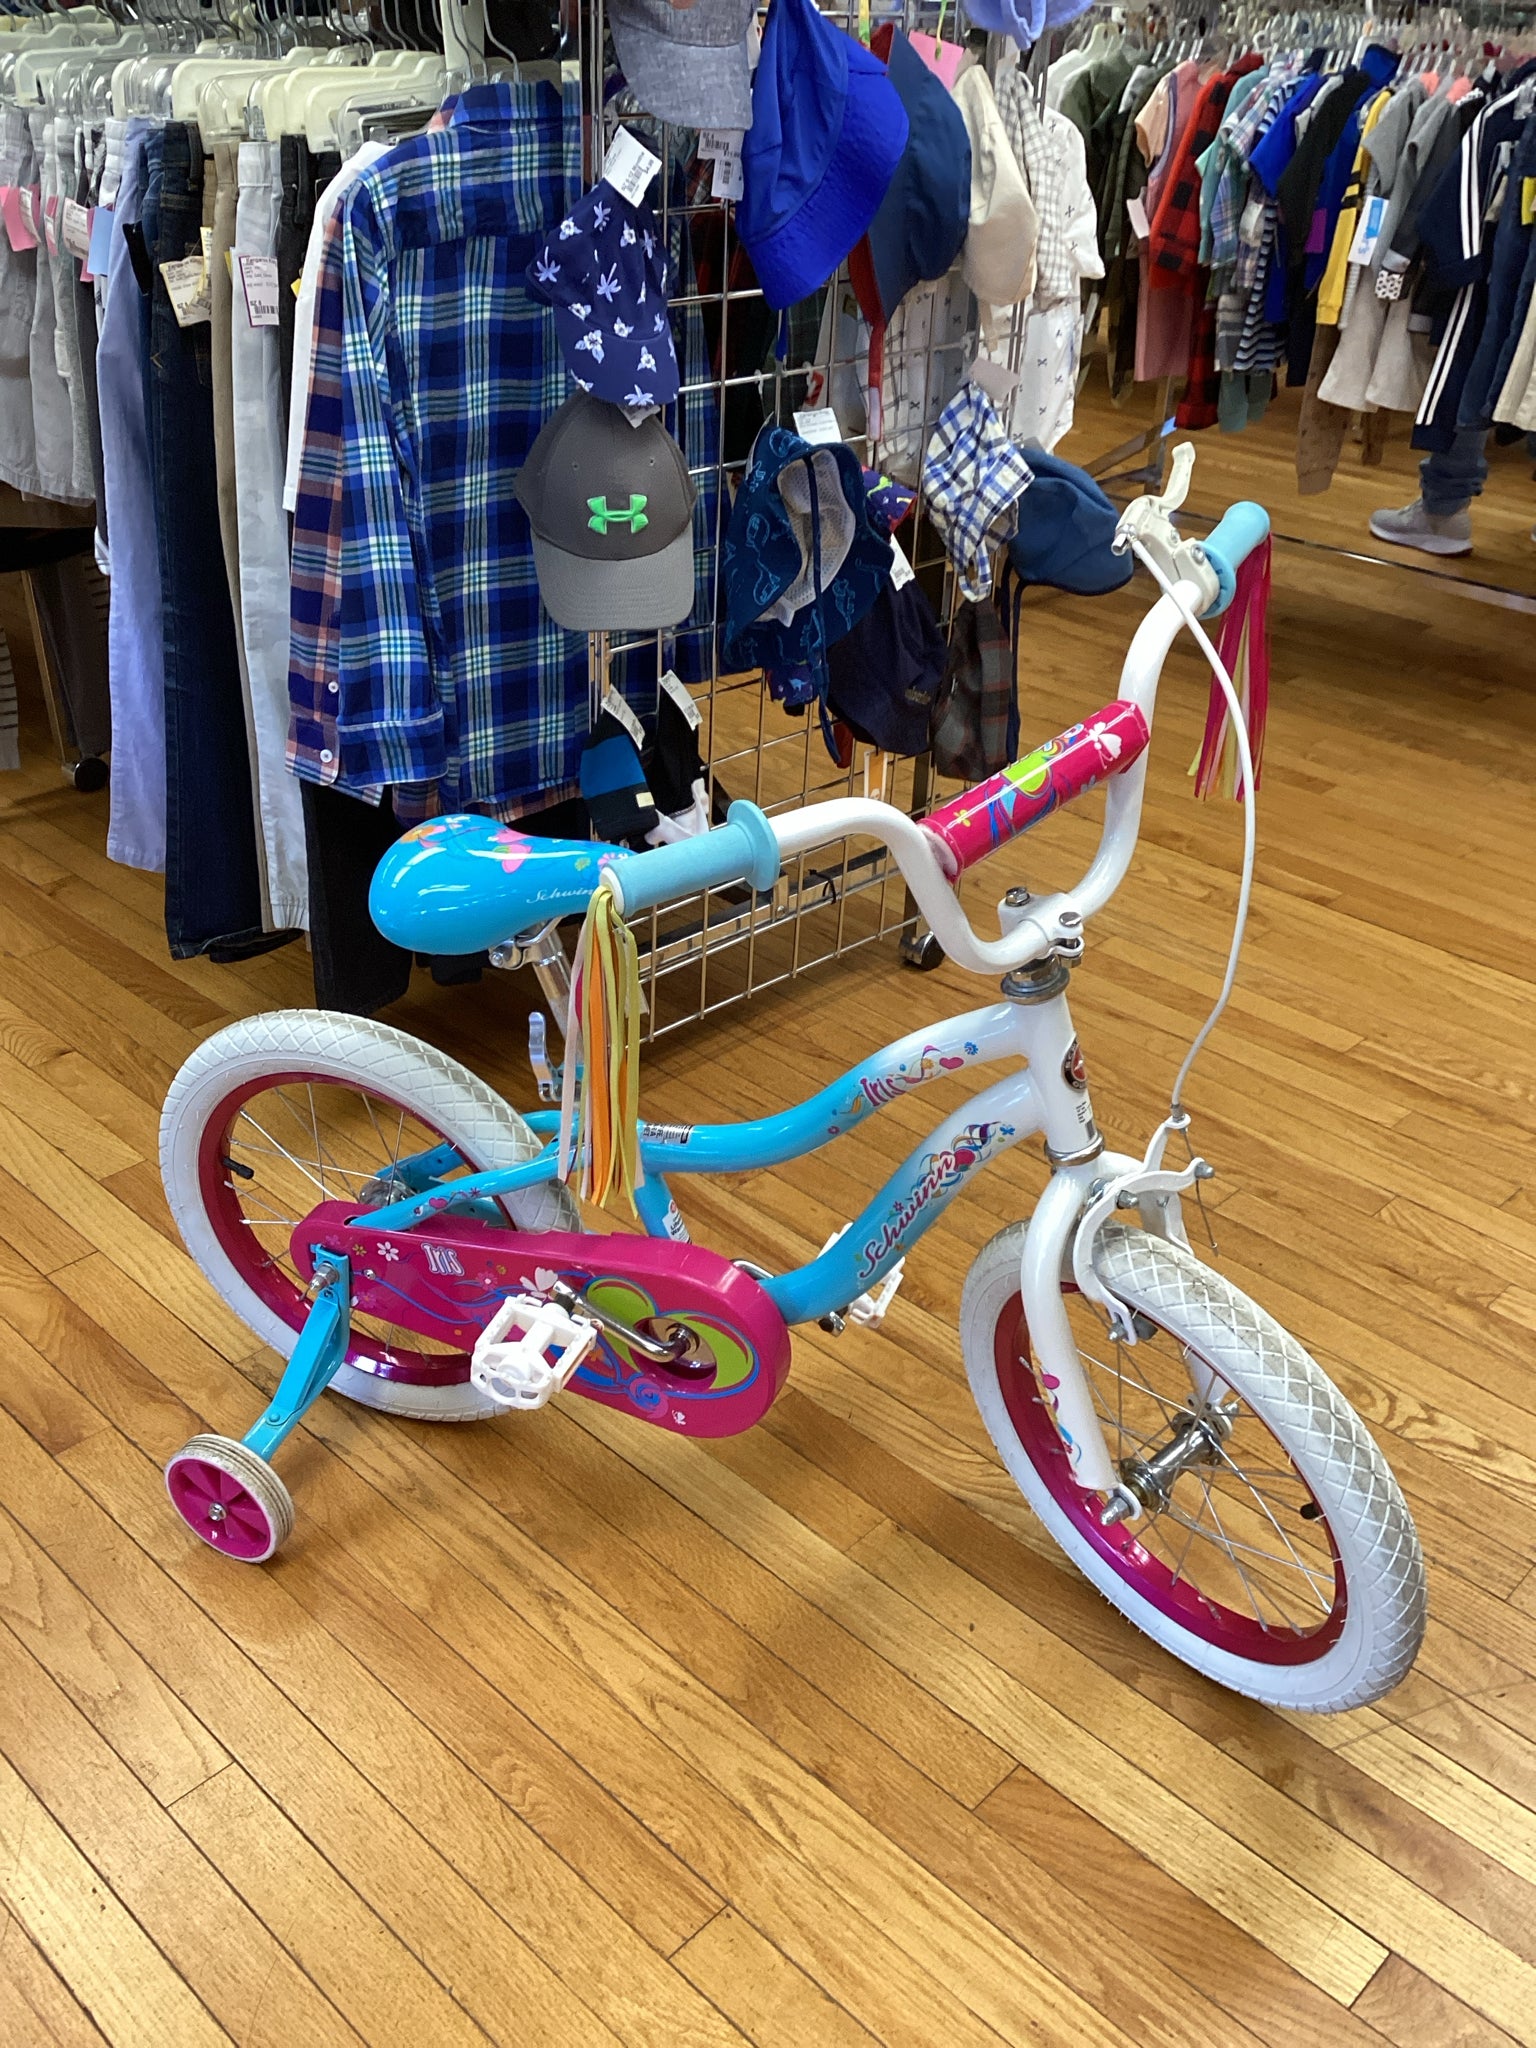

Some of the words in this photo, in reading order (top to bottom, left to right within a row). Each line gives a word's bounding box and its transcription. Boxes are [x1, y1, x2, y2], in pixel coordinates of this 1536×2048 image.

[860, 1077, 906, 1107] Iris
[859, 1153, 954, 1279] Schwinn
[421, 1243, 464, 1276] Iris
